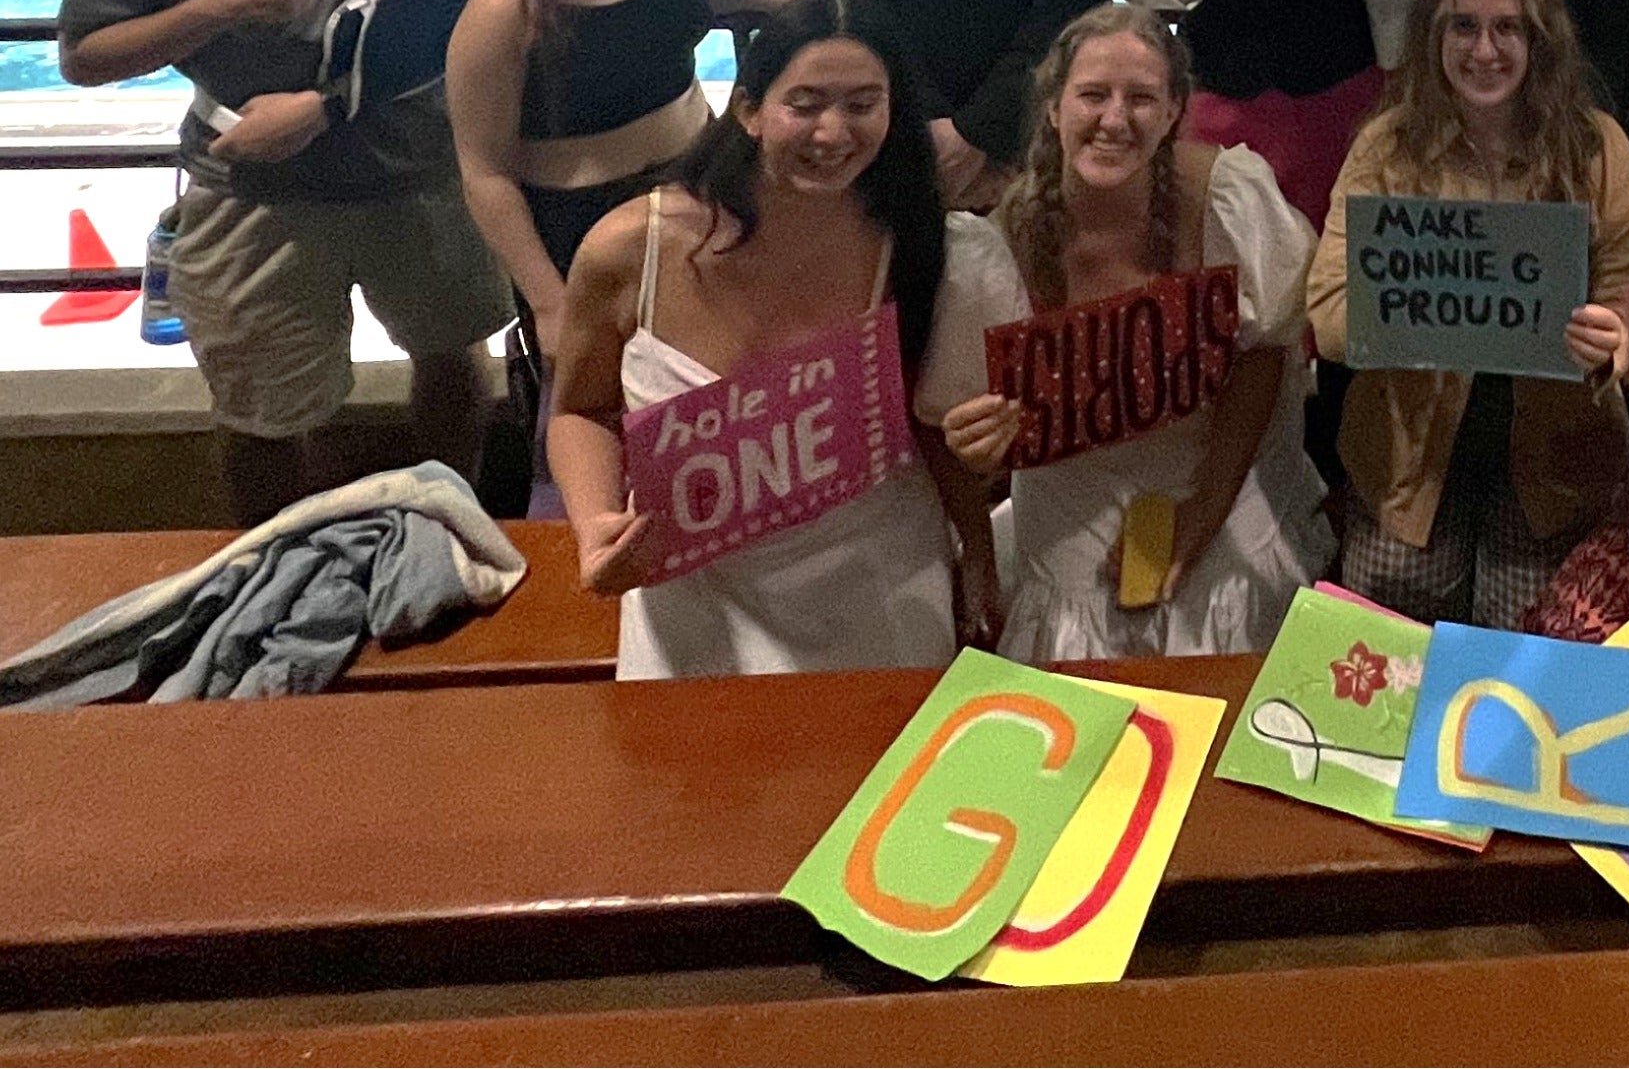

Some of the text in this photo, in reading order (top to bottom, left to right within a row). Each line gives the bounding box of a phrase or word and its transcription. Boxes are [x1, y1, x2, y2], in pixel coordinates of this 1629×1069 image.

[1372, 202, 1488, 240] MAKE
[1358, 245, 1544, 284] CONNIE G
[1378, 287, 1543, 335] PROUD!
[652, 358, 836, 457] hole in
[671, 397, 839, 533] ONE
[843, 692, 1077, 936] G
